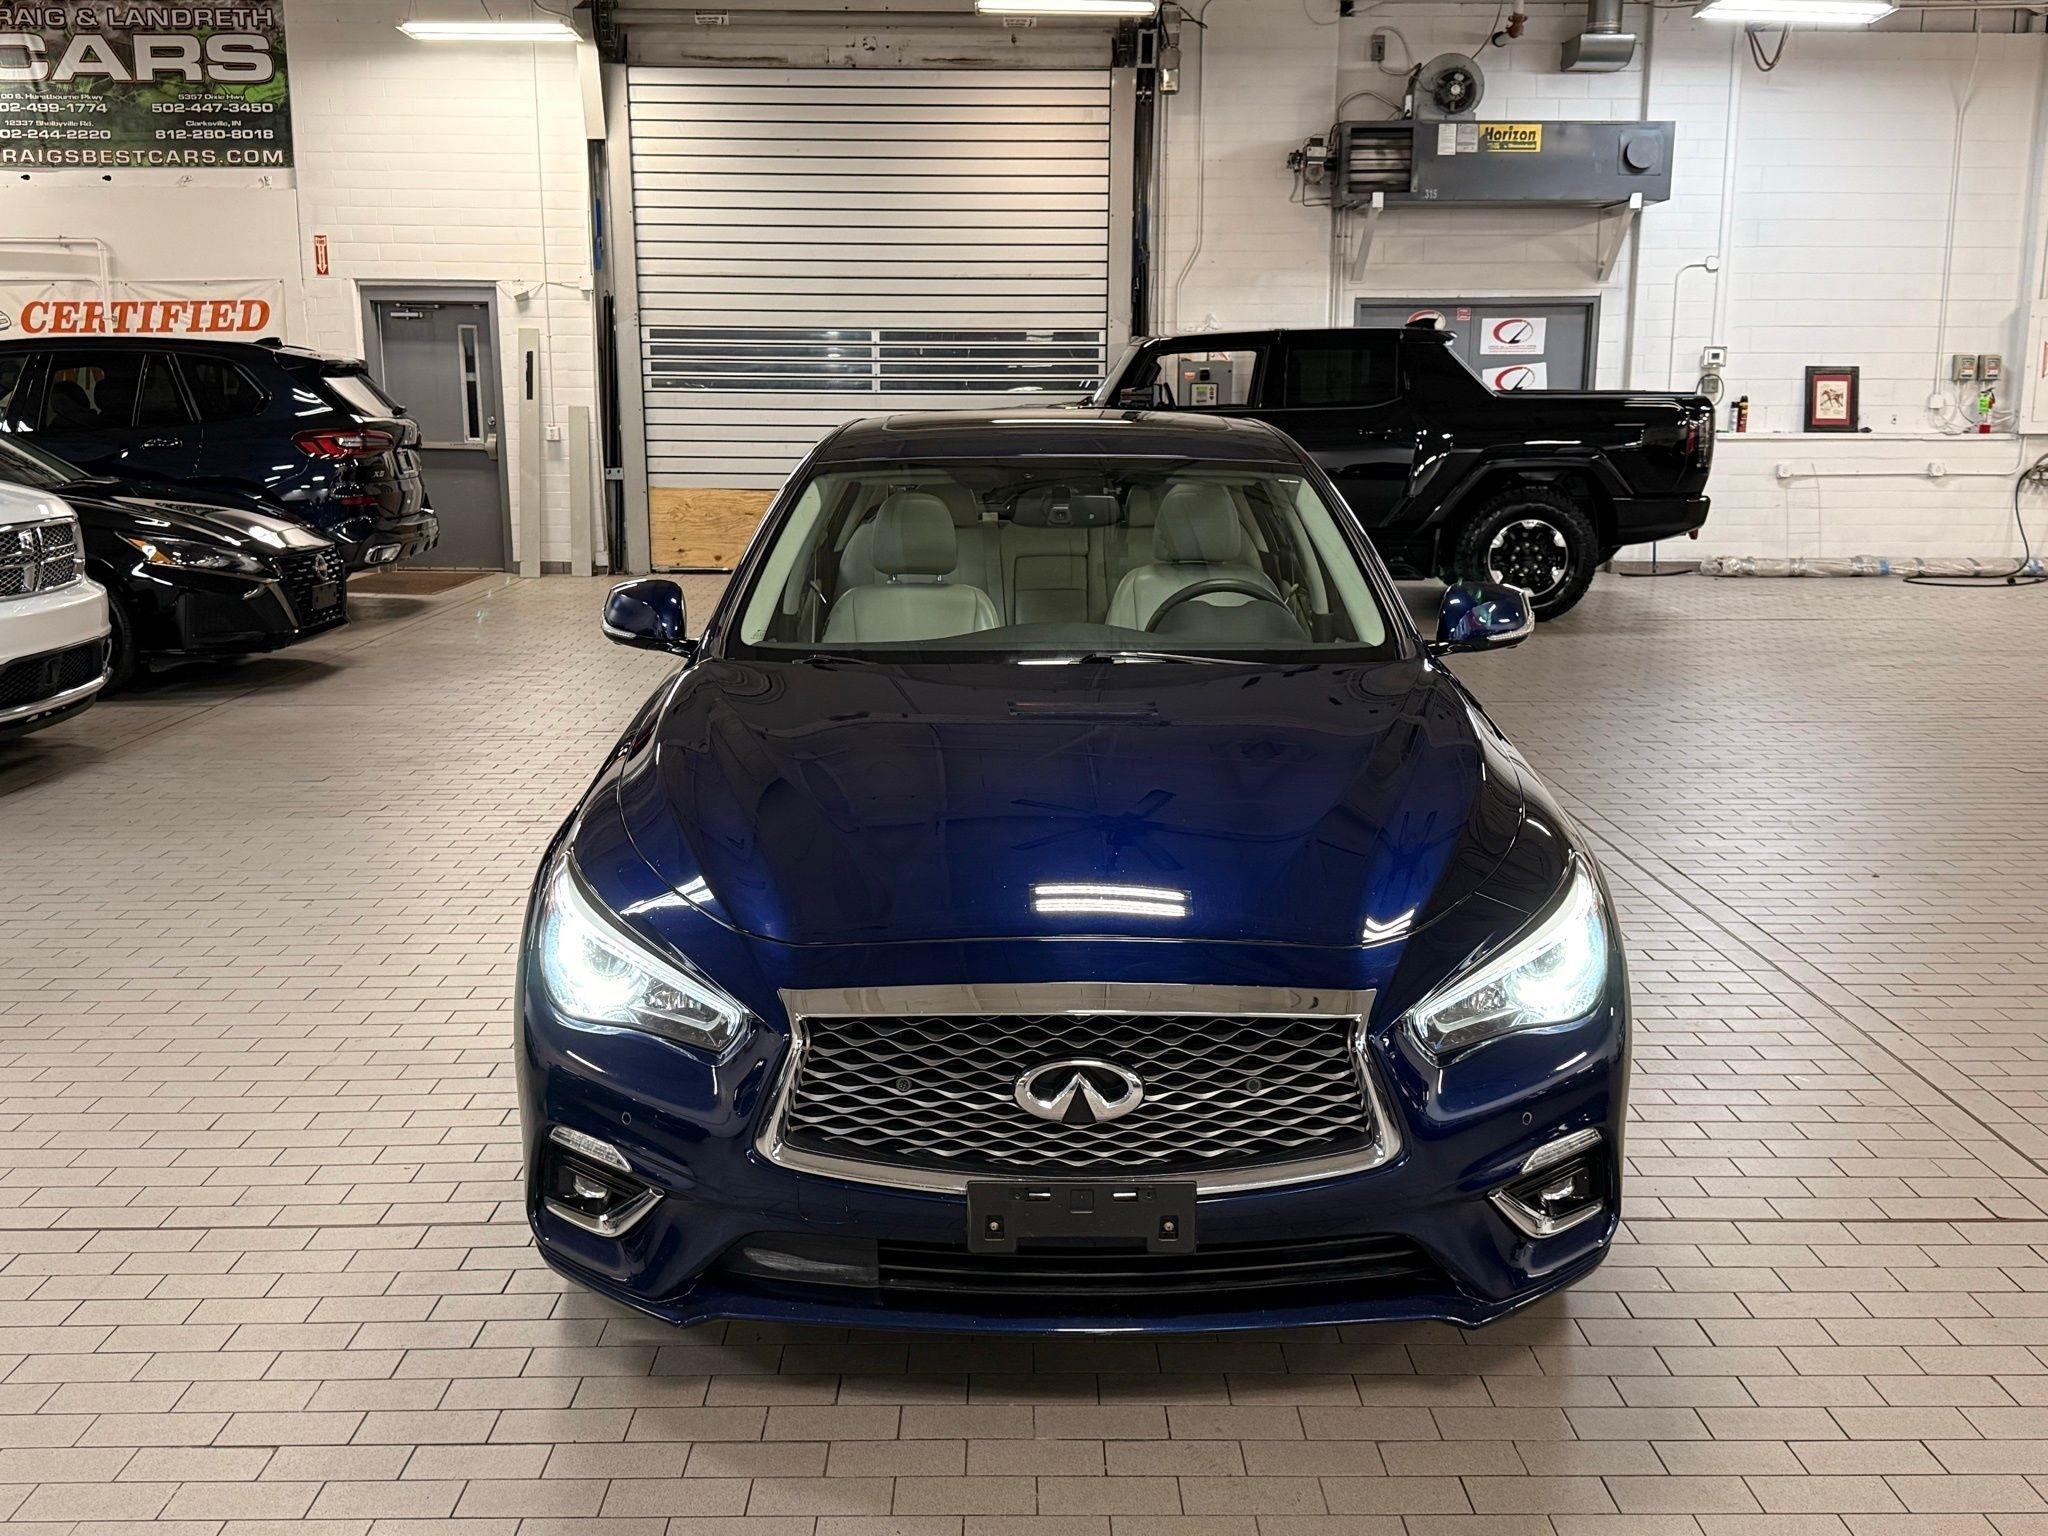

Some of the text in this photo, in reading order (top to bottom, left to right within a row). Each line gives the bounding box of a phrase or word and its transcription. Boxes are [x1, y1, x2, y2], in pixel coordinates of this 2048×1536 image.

[76, 9, 98, 26] &
[108, 9, 274, 26] LANDRETH
[0, 33, 275, 82] CARS
[81, 94, 104, 102] Pkwy
[151, 103, 274, 113] 502-447-3450
[155, 129, 275, 140] 812-280-8018
[1484, 126, 1537, 141] Horizon
[2, 149, 284, 164] RAIGSBESTCARS.COM
[20, 300, 271, 334] CERTIFIED
